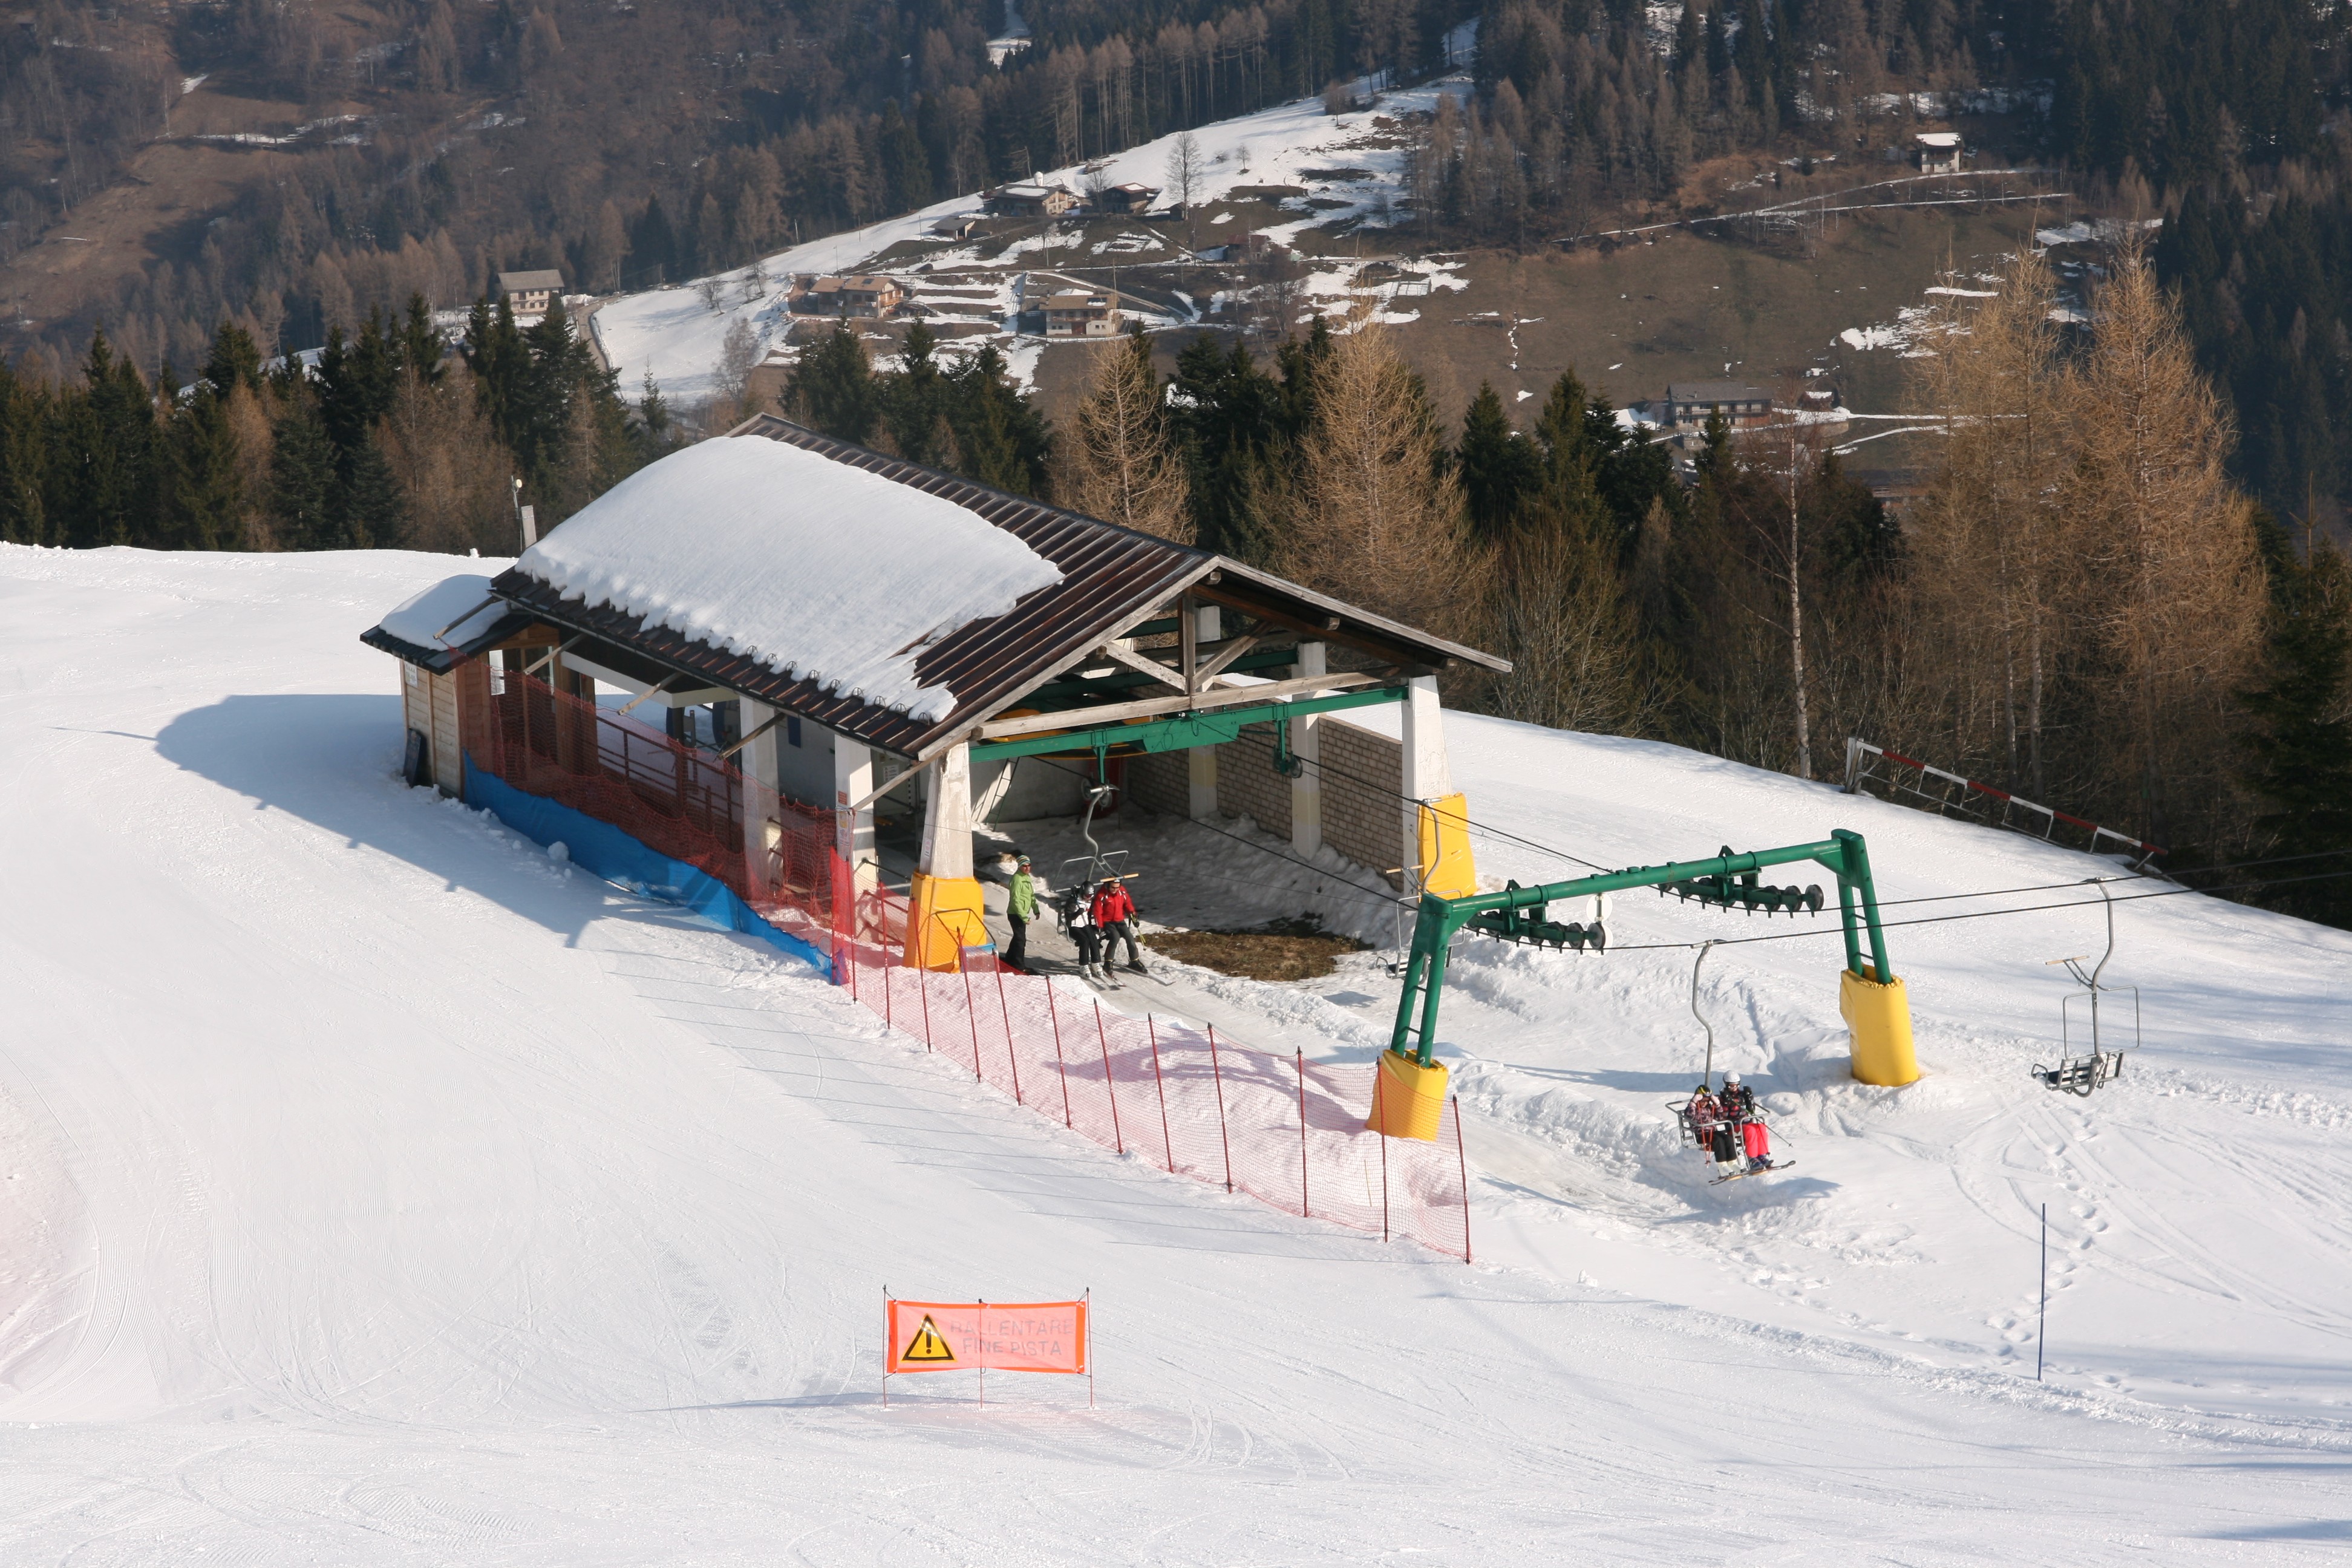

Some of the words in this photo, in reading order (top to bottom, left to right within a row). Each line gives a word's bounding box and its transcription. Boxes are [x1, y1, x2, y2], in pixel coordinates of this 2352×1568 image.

[950, 1319, 1074, 1336] RALLENTARE
[963, 1338, 1003, 1353] FINE
[1010, 1341, 1061, 1356] PISTA
